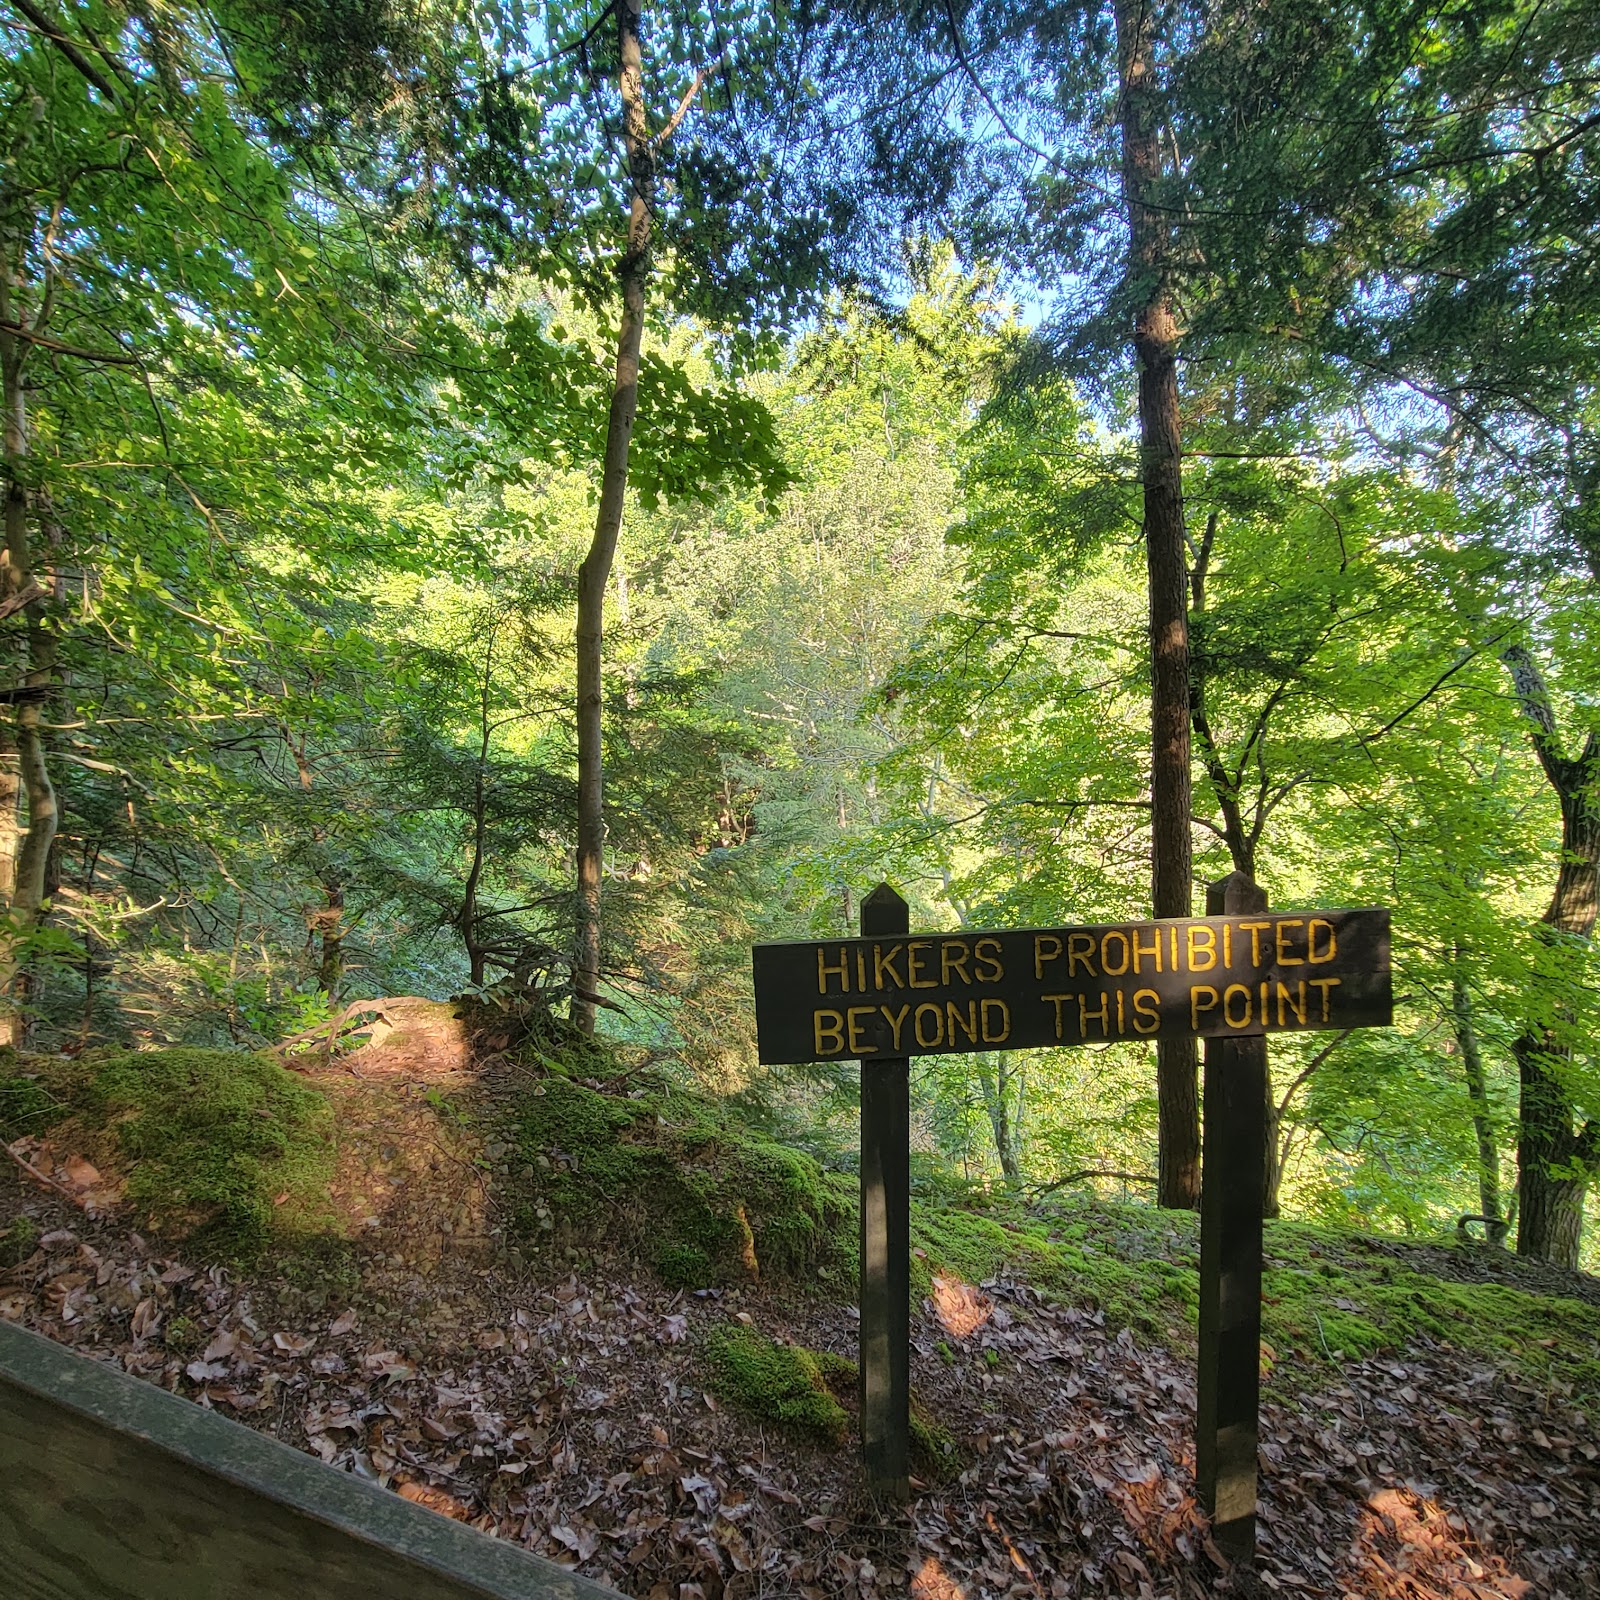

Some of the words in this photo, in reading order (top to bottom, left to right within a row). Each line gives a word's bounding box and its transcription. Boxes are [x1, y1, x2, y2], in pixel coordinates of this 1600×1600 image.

[817, 937, 1003, 994] HIKERS
[1034, 918, 1338, 980] PROHIBITED
[813, 998, 1011, 1056] BEYOND
[1041, 988, 1161, 1039] THIS
[1190, 978, 1341, 1030] POINT
